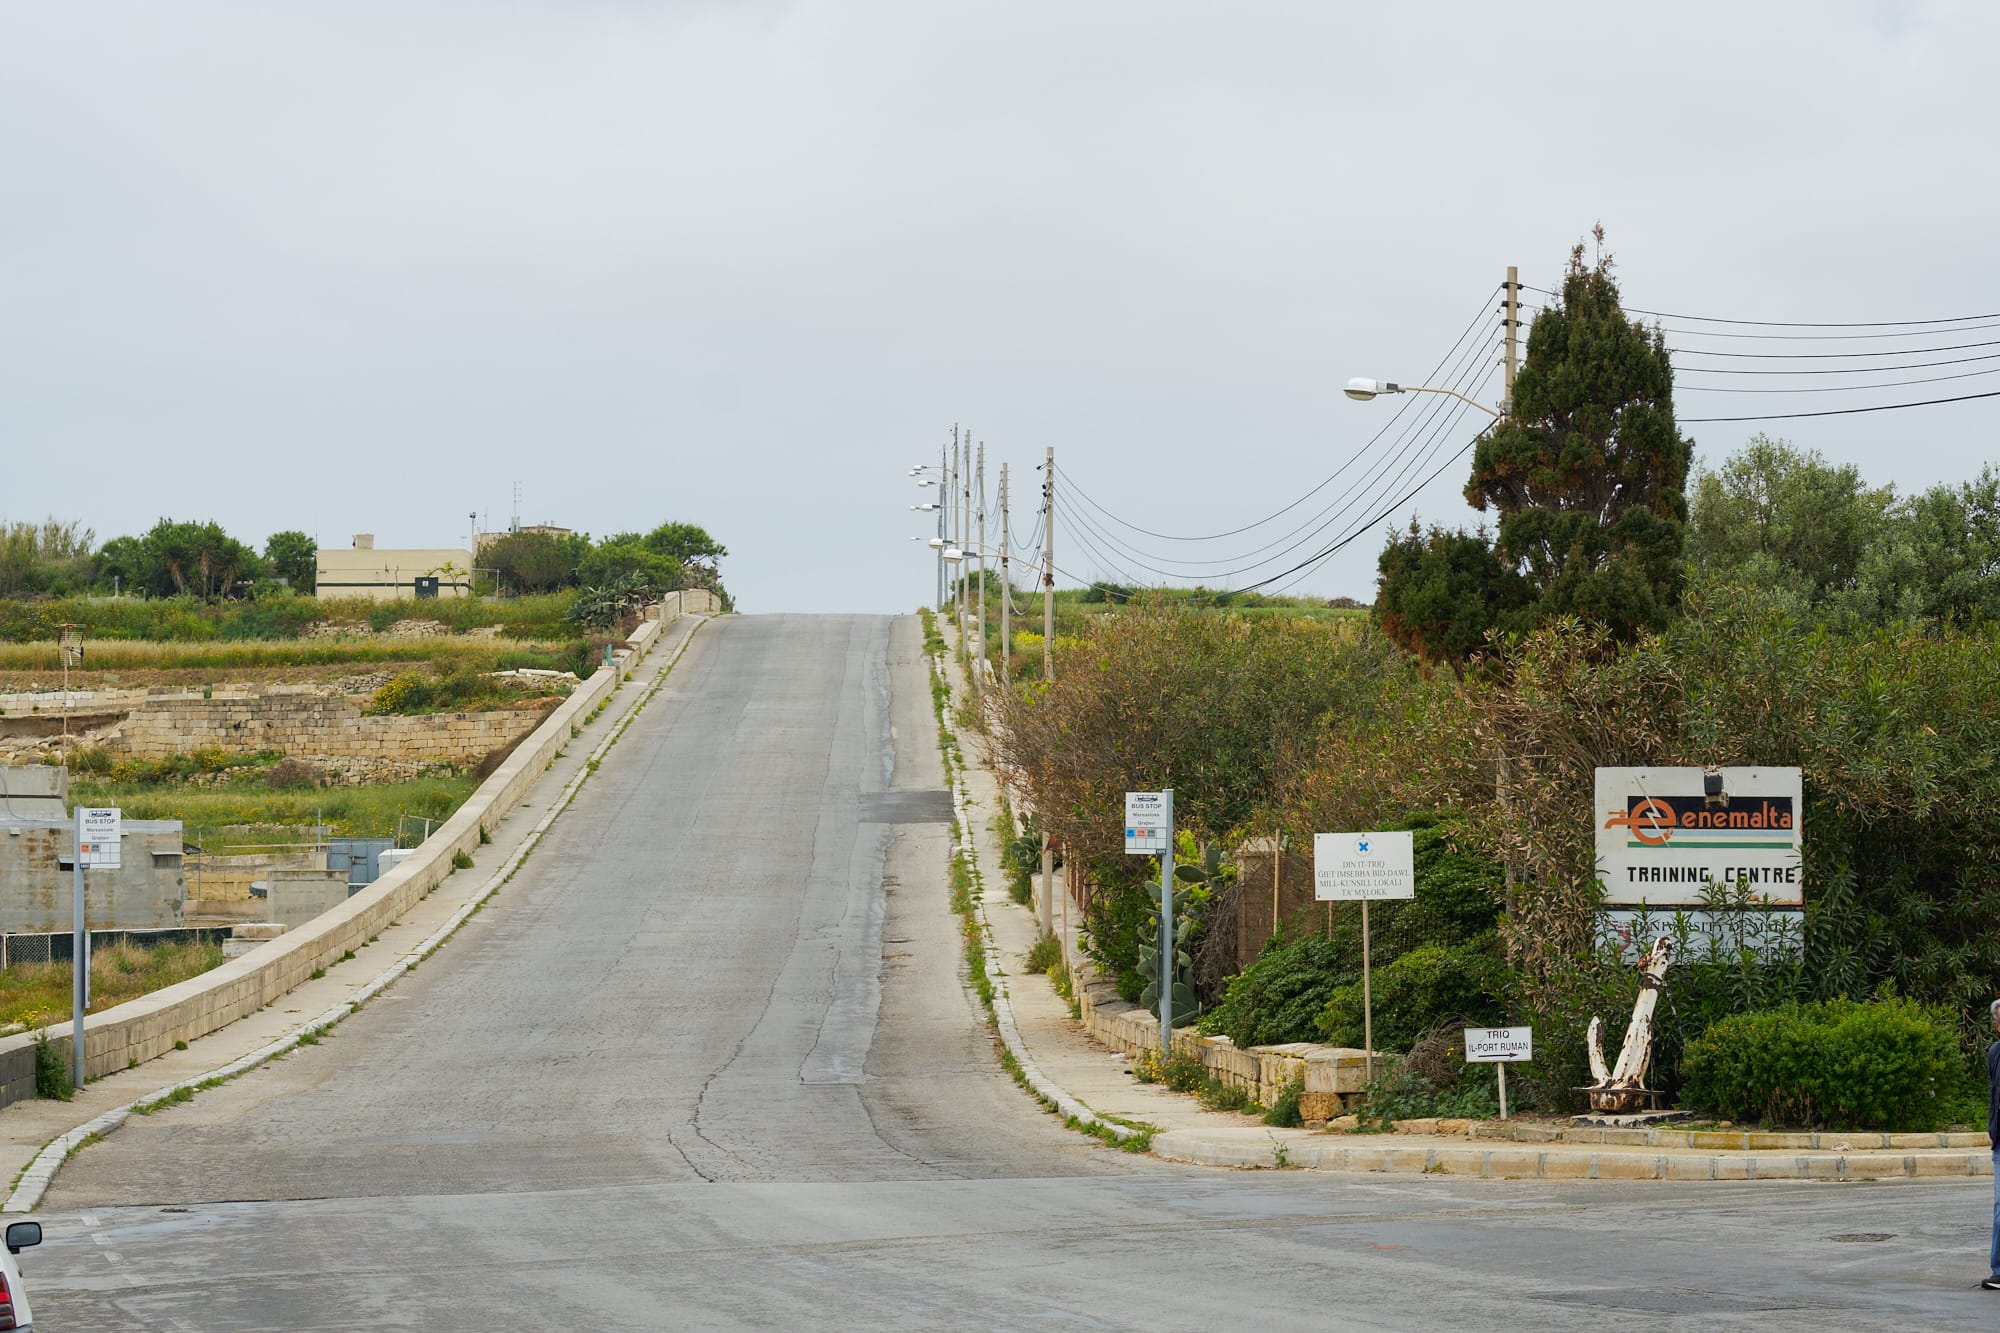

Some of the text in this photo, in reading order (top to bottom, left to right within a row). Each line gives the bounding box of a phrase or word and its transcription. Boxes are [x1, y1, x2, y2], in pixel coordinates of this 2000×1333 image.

[1681, 800, 1792, 828] enemalta
[1342, 860, 1385, 869] DIN IT-TRIQ
[1627, 866, 1795, 884] TRAINING CENTRE
[1374, 879, 1402, 887] LOKALI
[1486, 1030, 1510, 1039] TRIQ
[1469, 1041, 1529, 1052] IL-PORT RUMAN
